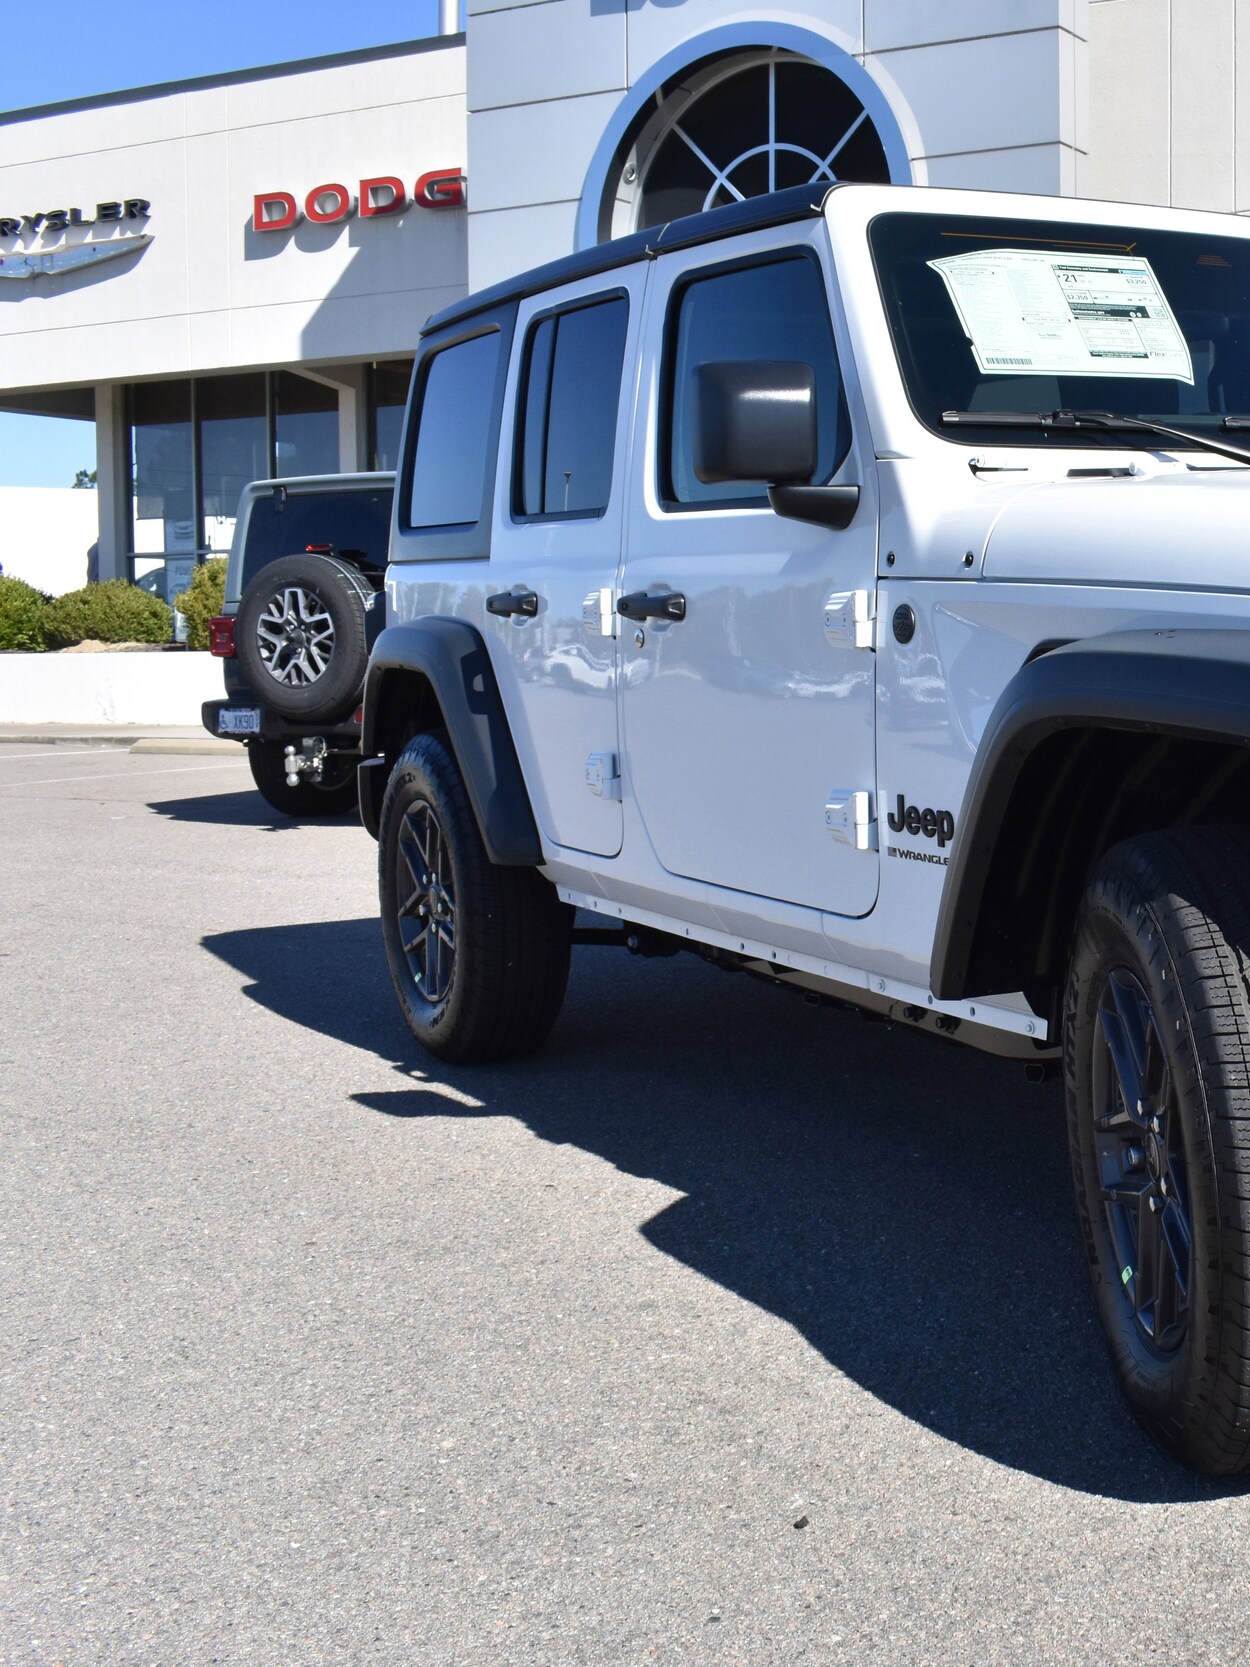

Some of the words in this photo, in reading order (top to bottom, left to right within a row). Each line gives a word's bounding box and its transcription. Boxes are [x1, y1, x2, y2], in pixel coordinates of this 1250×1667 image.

[253, 167, 463, 232] DODG
[1063, 274, 1077, 283] 21
[887, 793, 954, 848] Jeep
